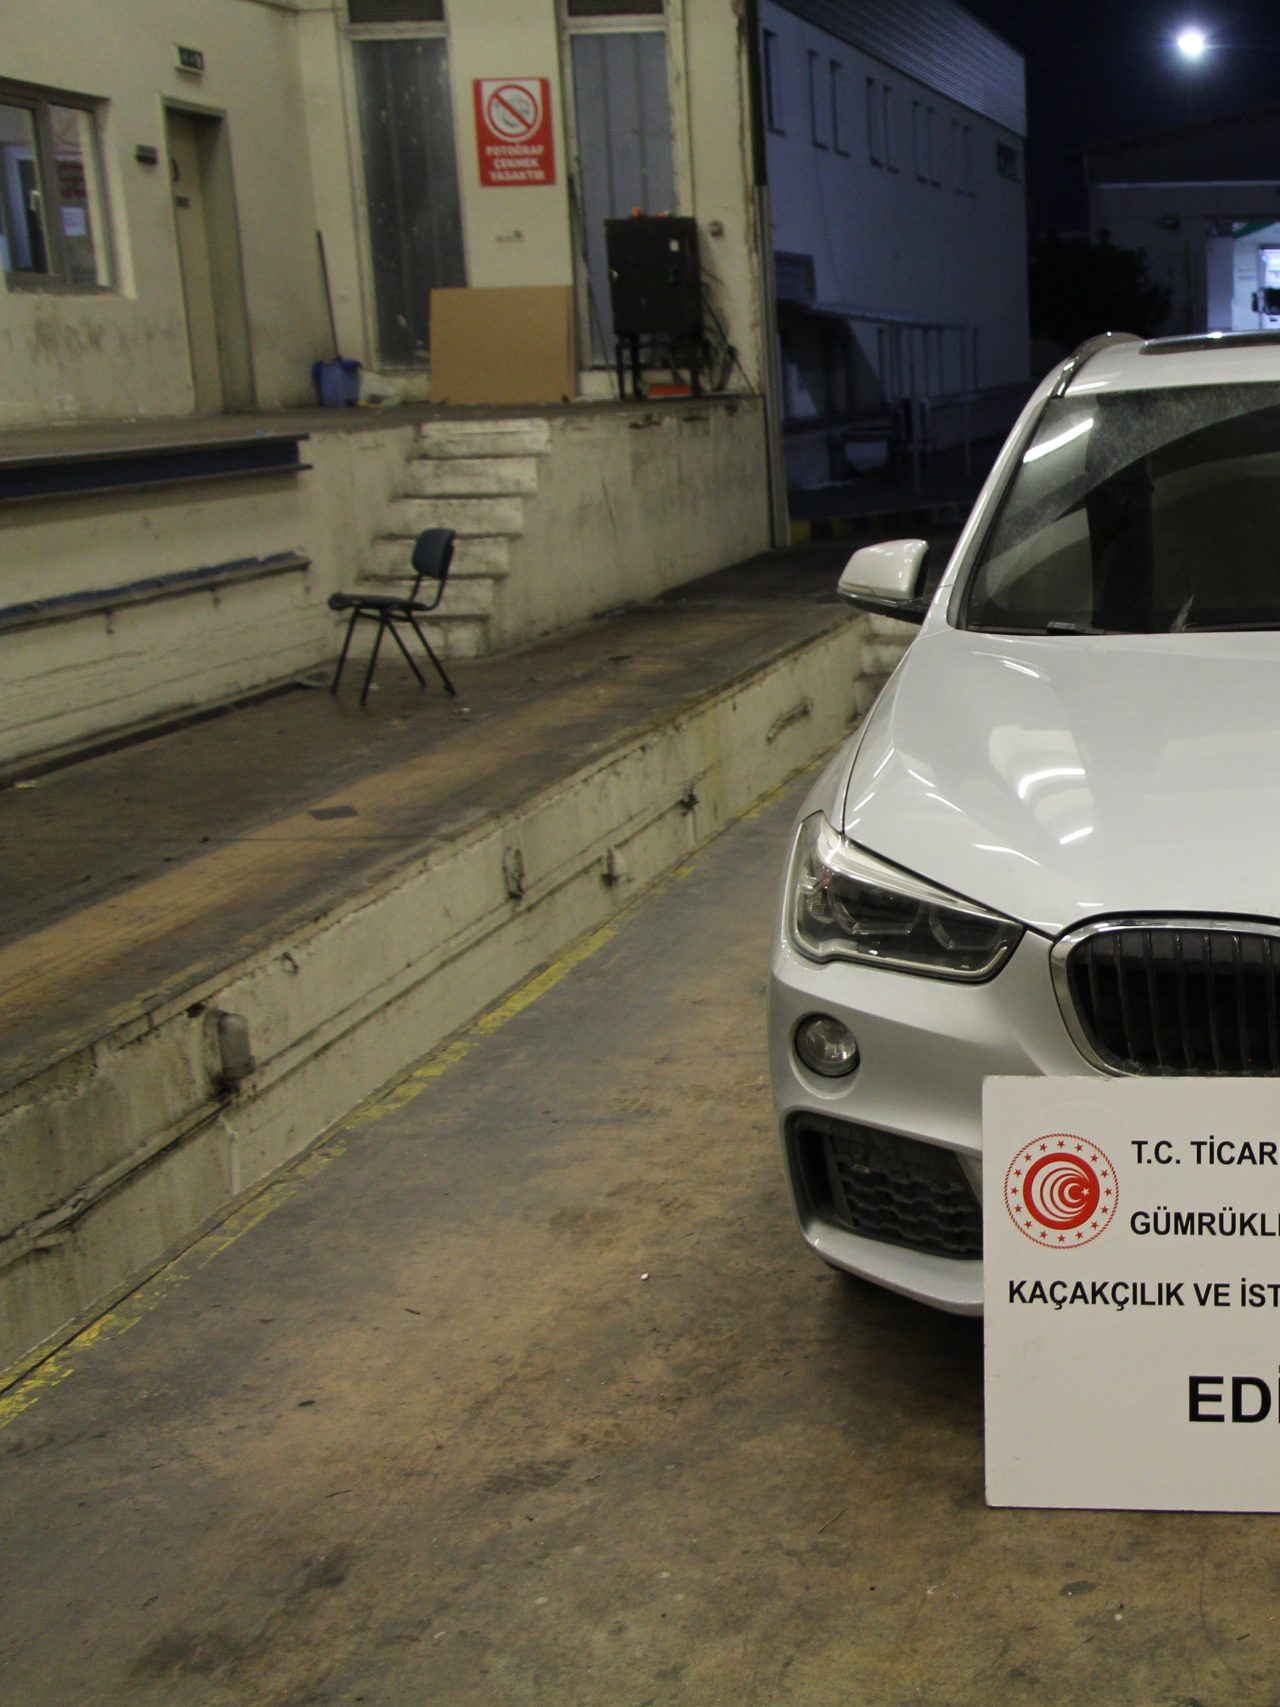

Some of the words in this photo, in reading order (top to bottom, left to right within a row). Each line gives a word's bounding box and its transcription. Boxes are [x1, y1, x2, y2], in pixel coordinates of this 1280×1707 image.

[1132, 1140, 1181, 1165] T.C.
[1008, 1279, 1185, 1312] KAÇAKÇILIK
[1193, 1283, 1231, 1308] VE
